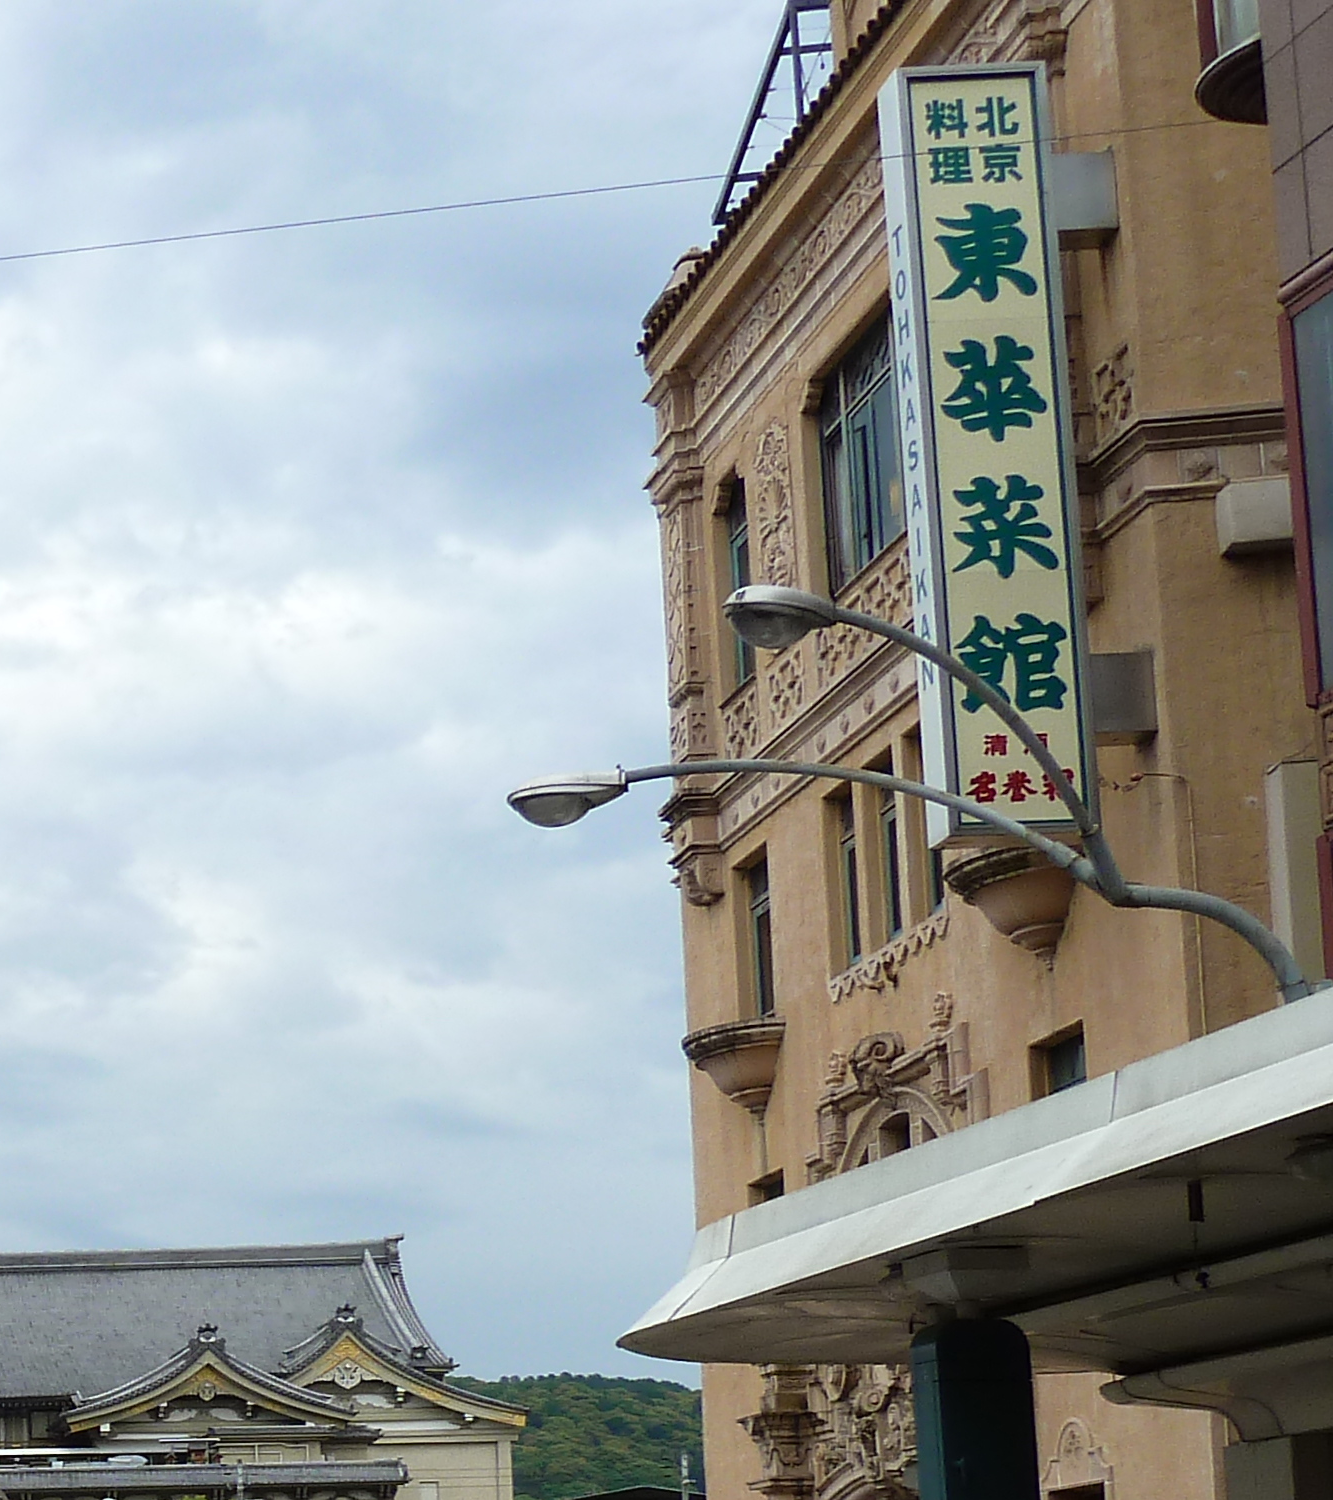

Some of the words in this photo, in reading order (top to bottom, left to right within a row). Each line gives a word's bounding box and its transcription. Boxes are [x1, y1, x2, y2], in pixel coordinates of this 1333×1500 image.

[924, 98, 974, 185] 料理
[974, 96, 1024, 184] 北京
[892, 224, 935, 691] TOHKASAIKAN
[931, 202, 1068, 714] 東華菜館
